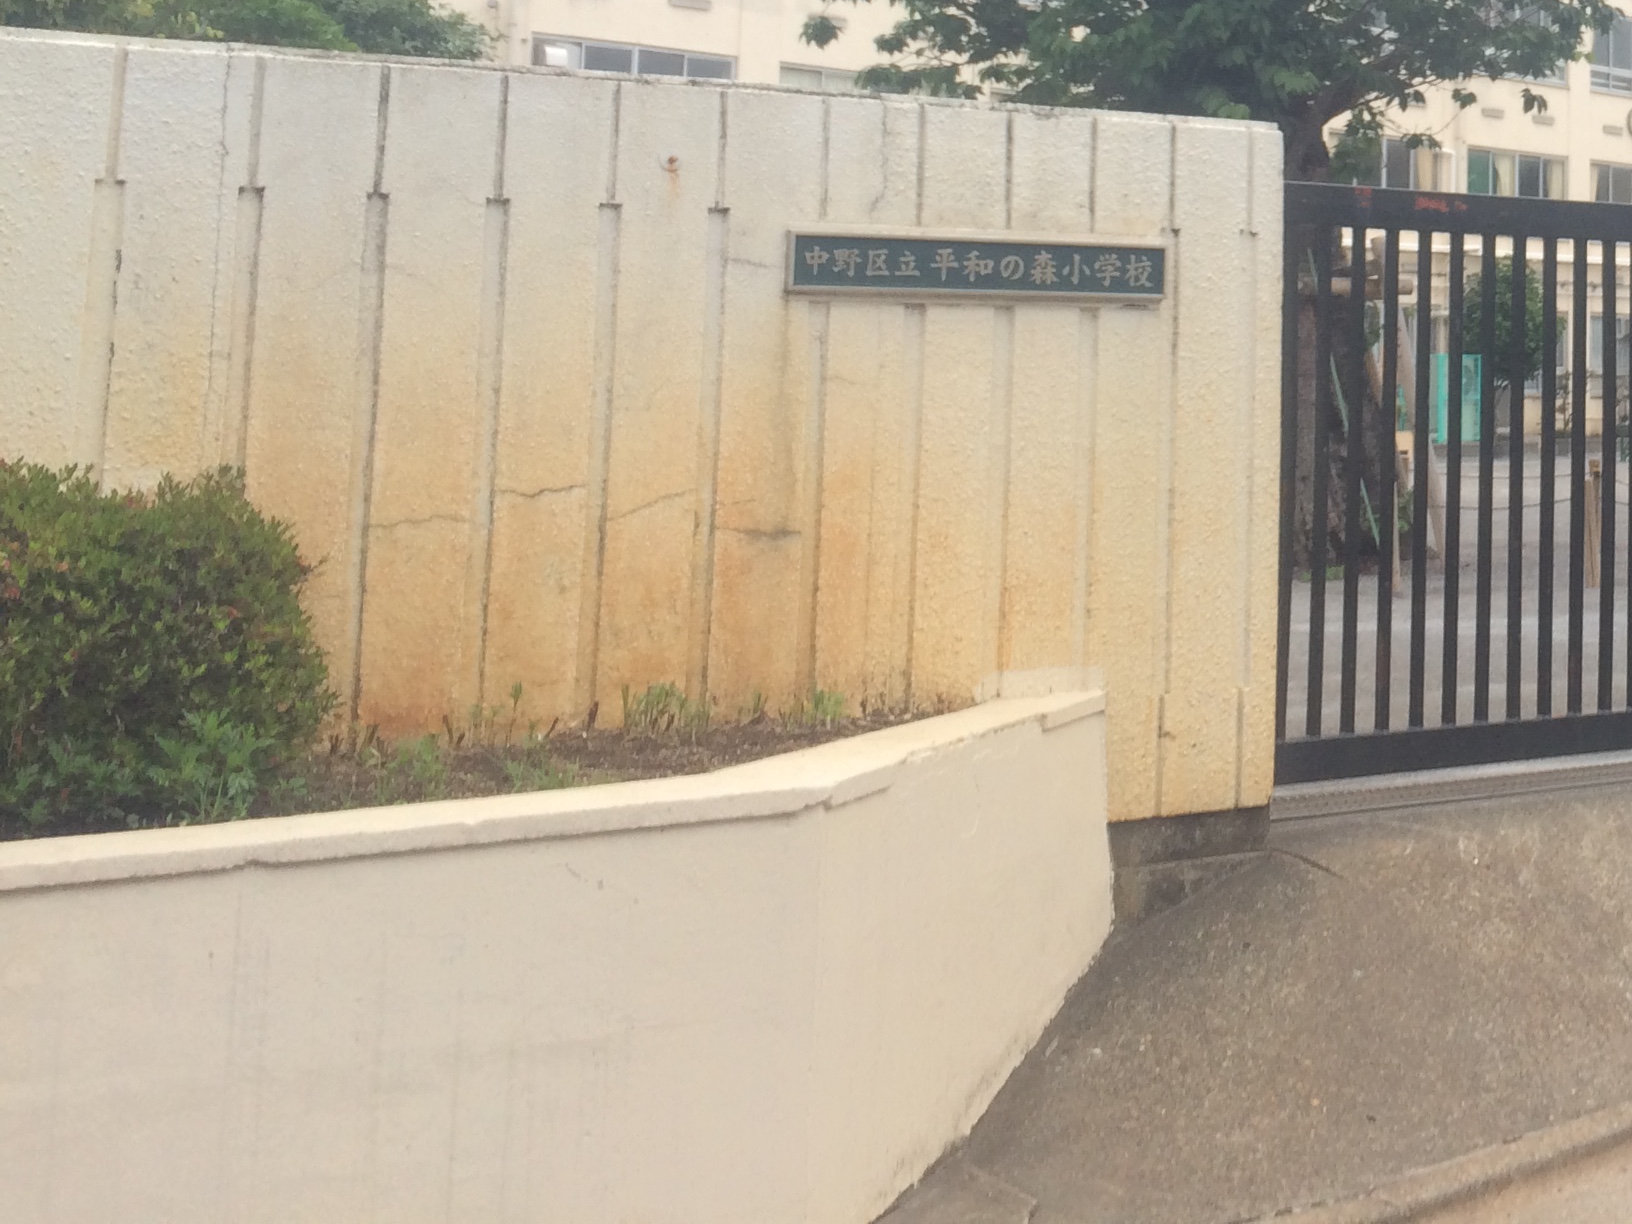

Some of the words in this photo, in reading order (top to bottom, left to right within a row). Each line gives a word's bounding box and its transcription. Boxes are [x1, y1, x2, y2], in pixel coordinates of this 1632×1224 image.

[804, 245, 1154, 287] 中野区立平和の森小学校
